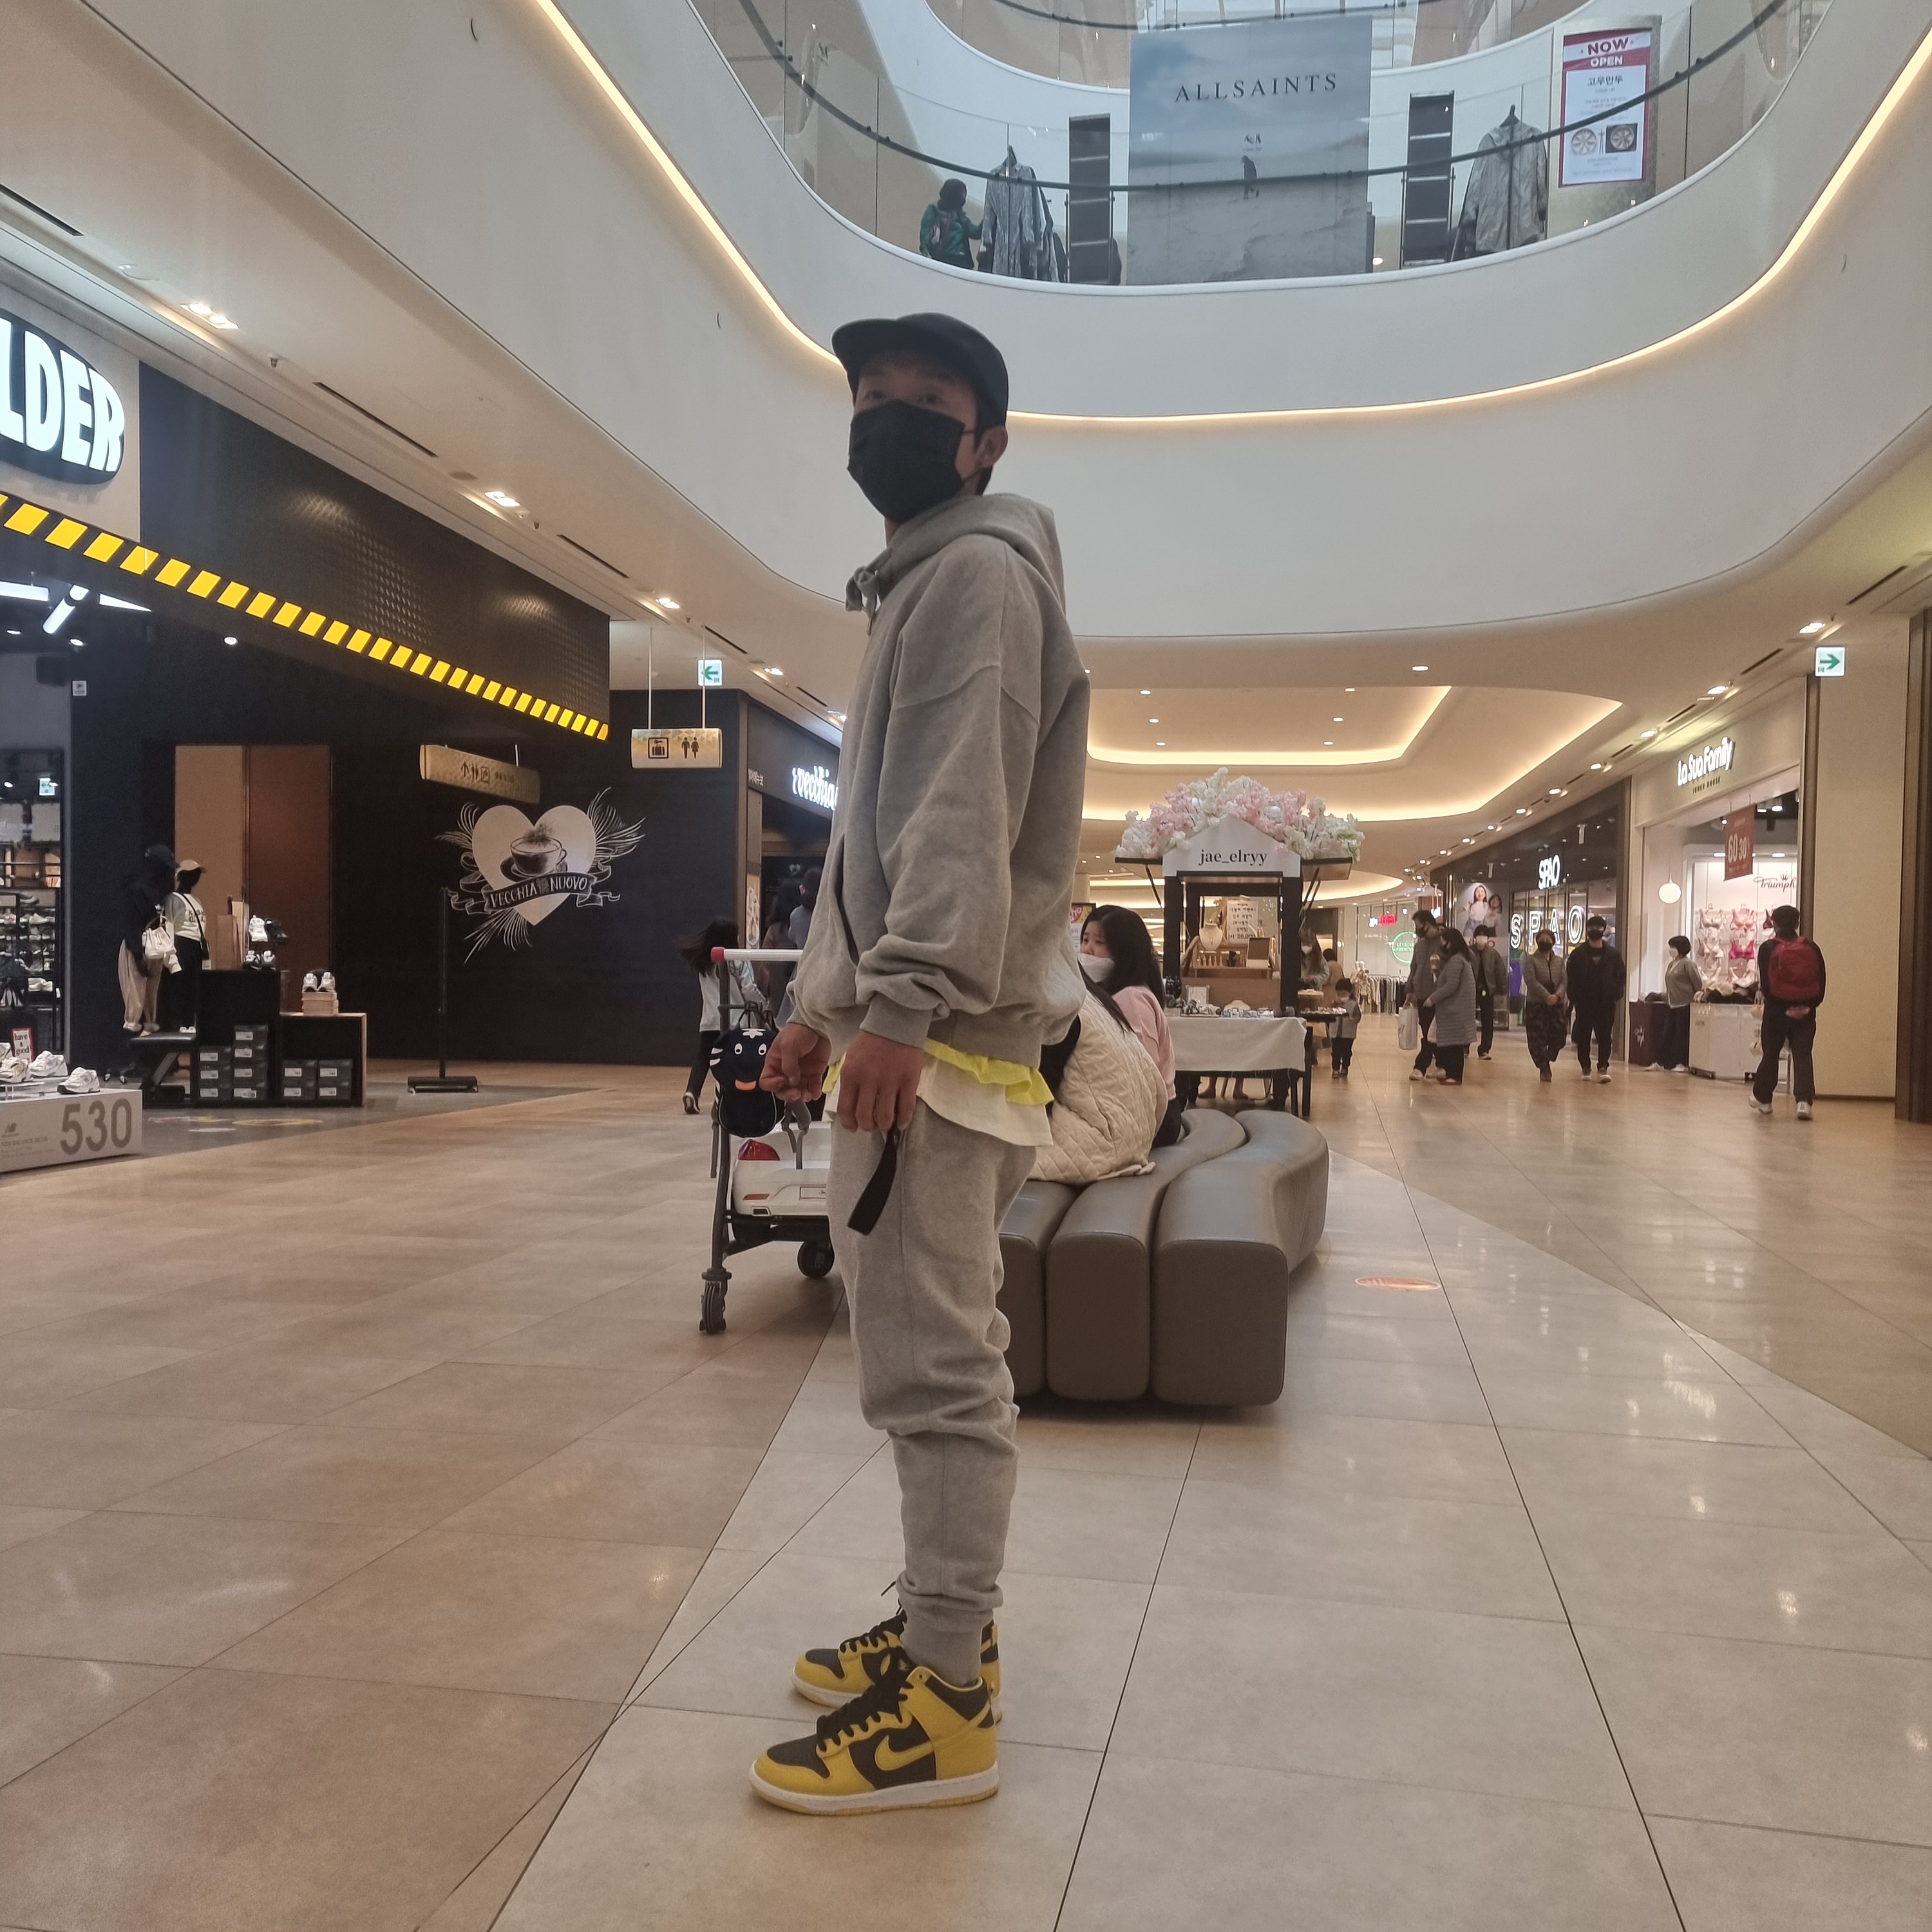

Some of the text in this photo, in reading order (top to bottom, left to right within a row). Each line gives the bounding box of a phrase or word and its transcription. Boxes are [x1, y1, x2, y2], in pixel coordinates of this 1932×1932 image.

[1587, 37, 1629, 55] NOW
[1590, 55, 1624, 68] OPEN
[1175, 73, 1336, 102] ALLSAINTS
[0, 316, 125, 473] LDER
[1677, 736, 1734, 786] La Sua Family
[1198, 849, 1267, 866] jae_elryy
[1728, 833, 1738, 864] 60
[1538, 854, 1561, 891] SPAO
[1753, 876, 1797, 893] Triumph
[489, 882, 538, 908] VECCHIA
[550, 876, 588, 892] NUOVO
[1510, 904, 1585, 949] SPAO
[16, 1045, 30, 1056] good
[60, 1097, 133, 1156] 530
